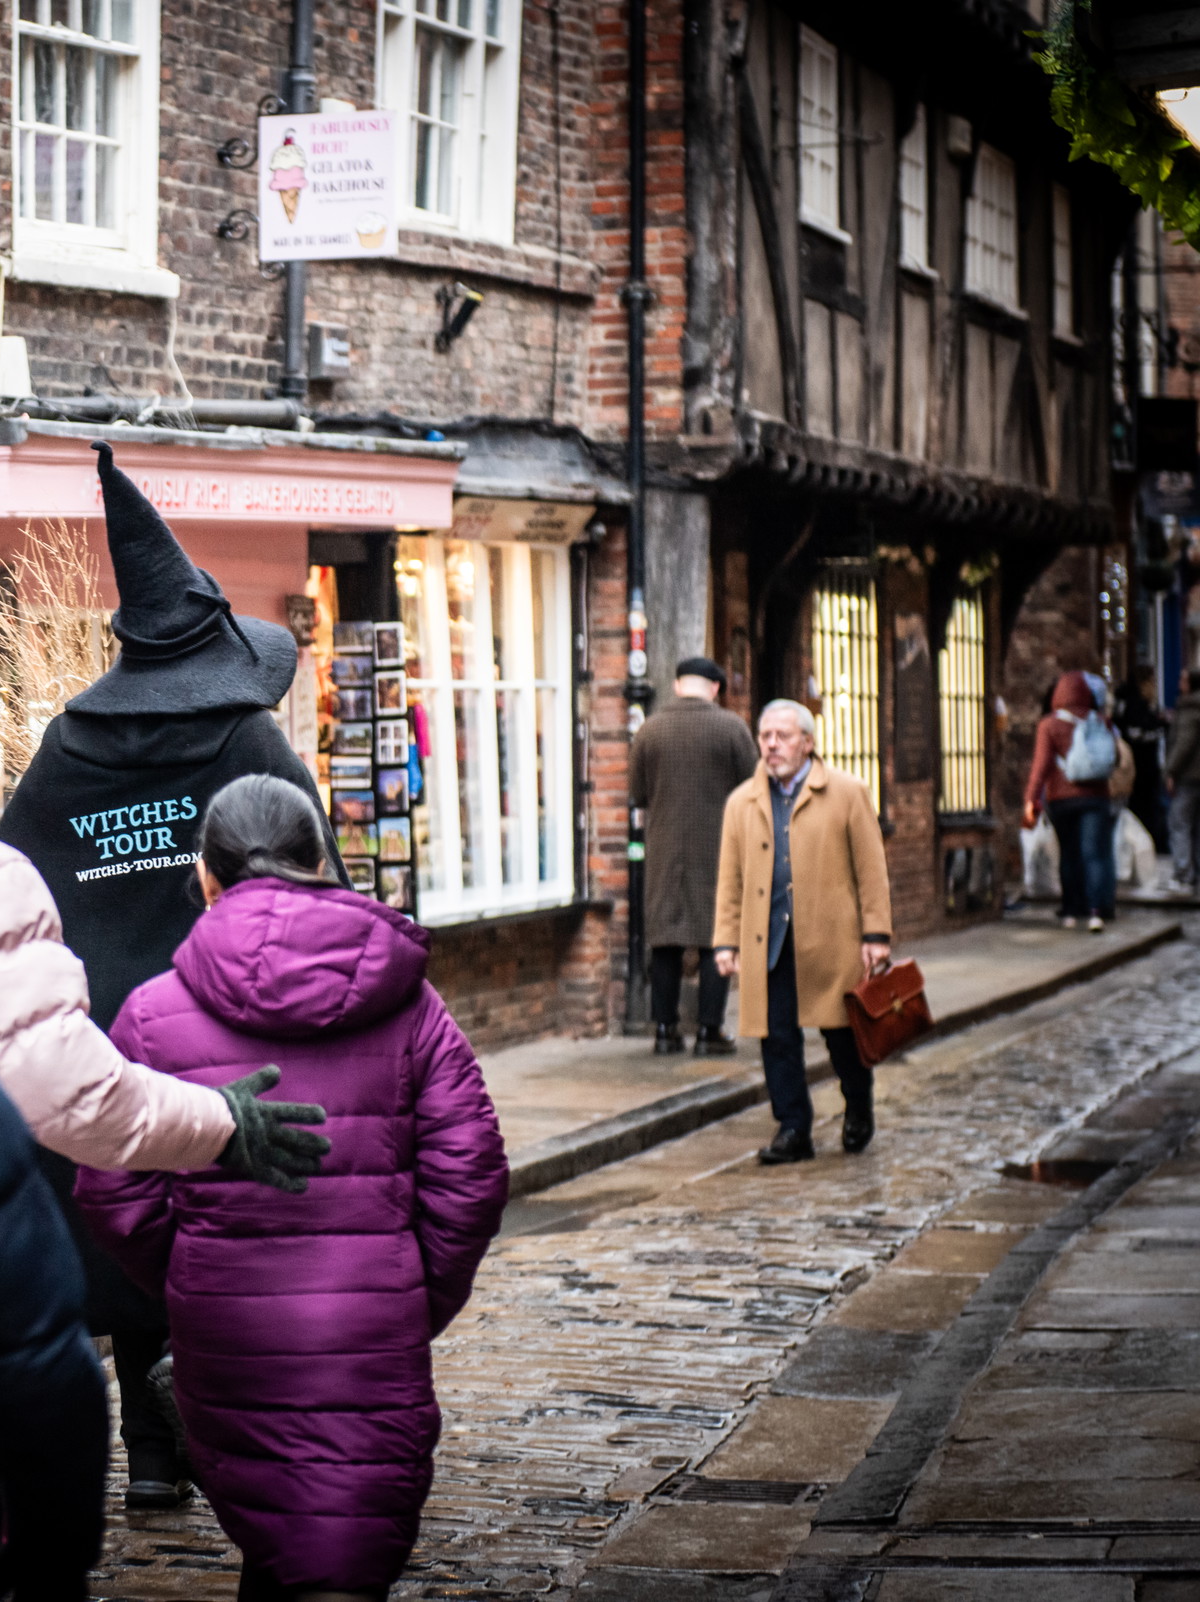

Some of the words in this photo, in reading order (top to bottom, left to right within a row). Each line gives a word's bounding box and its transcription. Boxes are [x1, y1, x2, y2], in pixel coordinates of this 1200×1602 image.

[310, 119, 391, 135] FABULOUSLY
[312, 160, 361, 174] GELATO
[312, 178, 386, 194] BAKEHOUSE
[195, 478, 231, 511] RICH
[245, 480, 329, 514] BAKEHOUSE
[346, 483, 396, 516] GELATO
[69, 796, 198, 838] WITCHES
[96, 826, 178, 860] TOUR
[76, 851, 203, 882] WITCHES-TOUR.COM
